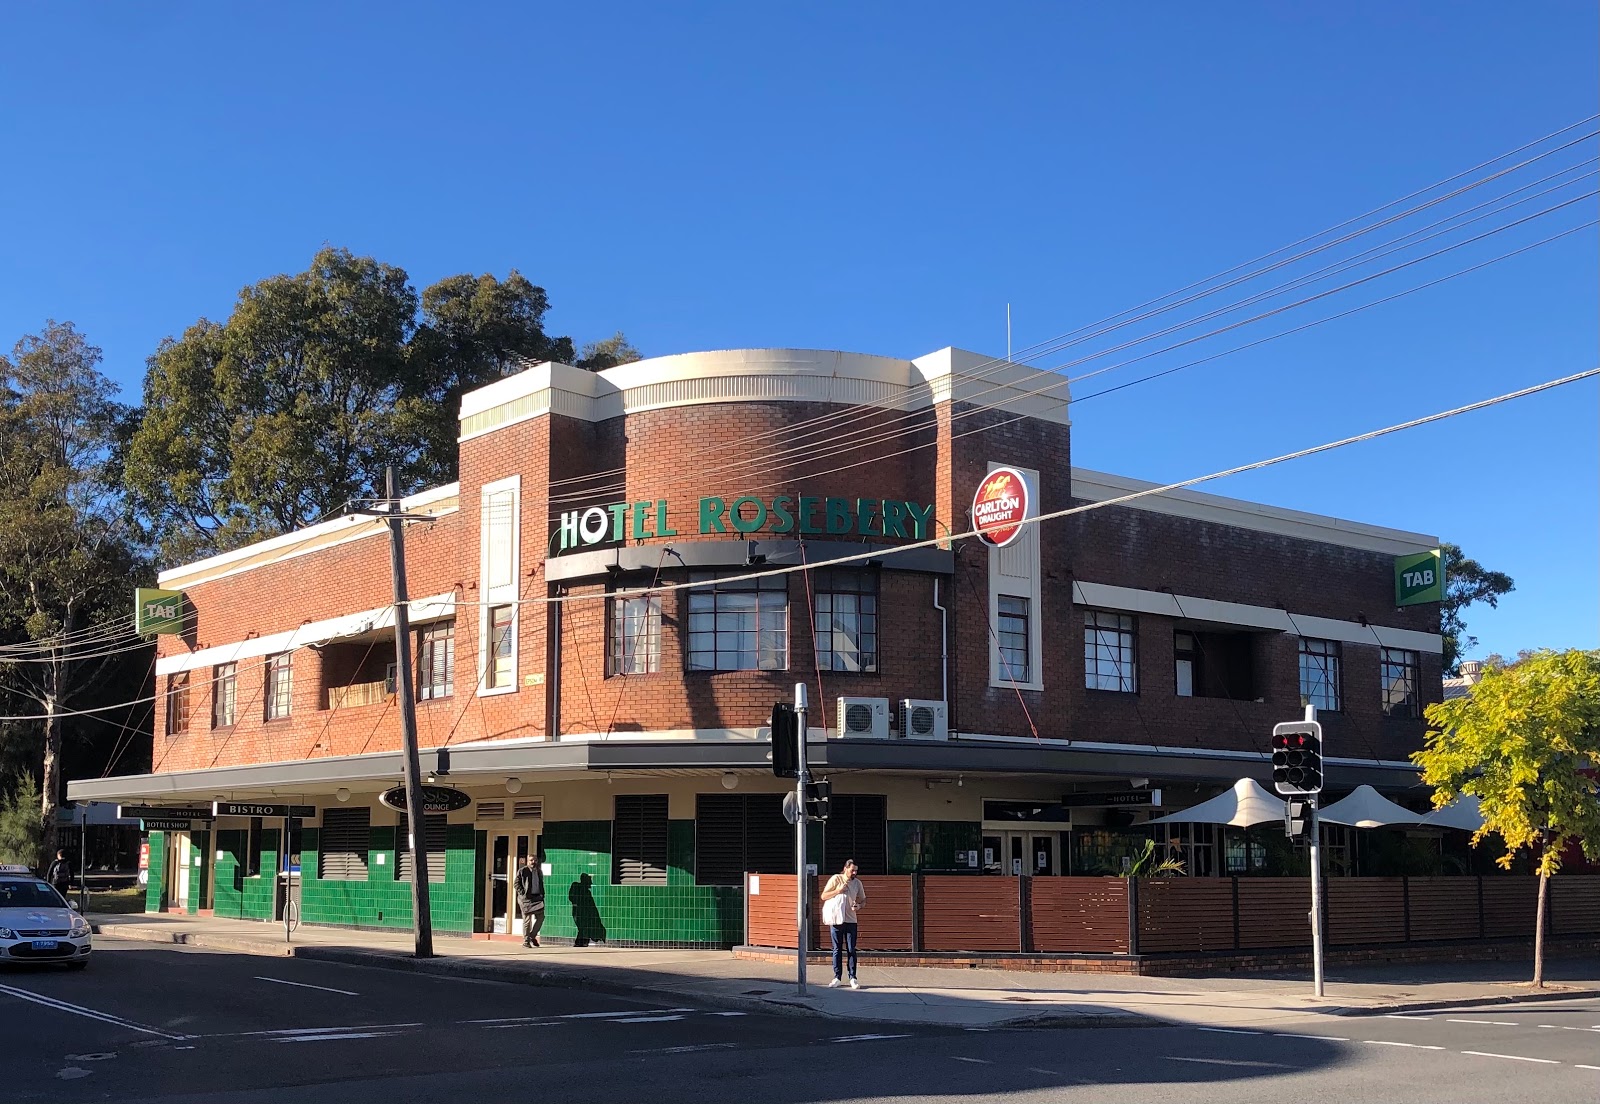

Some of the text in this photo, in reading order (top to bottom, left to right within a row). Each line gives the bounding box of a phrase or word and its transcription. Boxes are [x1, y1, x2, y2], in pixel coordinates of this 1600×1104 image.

[975, 497, 1019, 516] CARLTON
[561, 496, 934, 549] HOTEL ROSEBERY
[979, 510, 1012, 524] DRAUGHT
[1403, 570, 1434, 587] TAB
[147, 604, 175, 618] TAB
[230, 805, 274, 814] BISTRO
[423, 803, 450, 811] OUNGE
